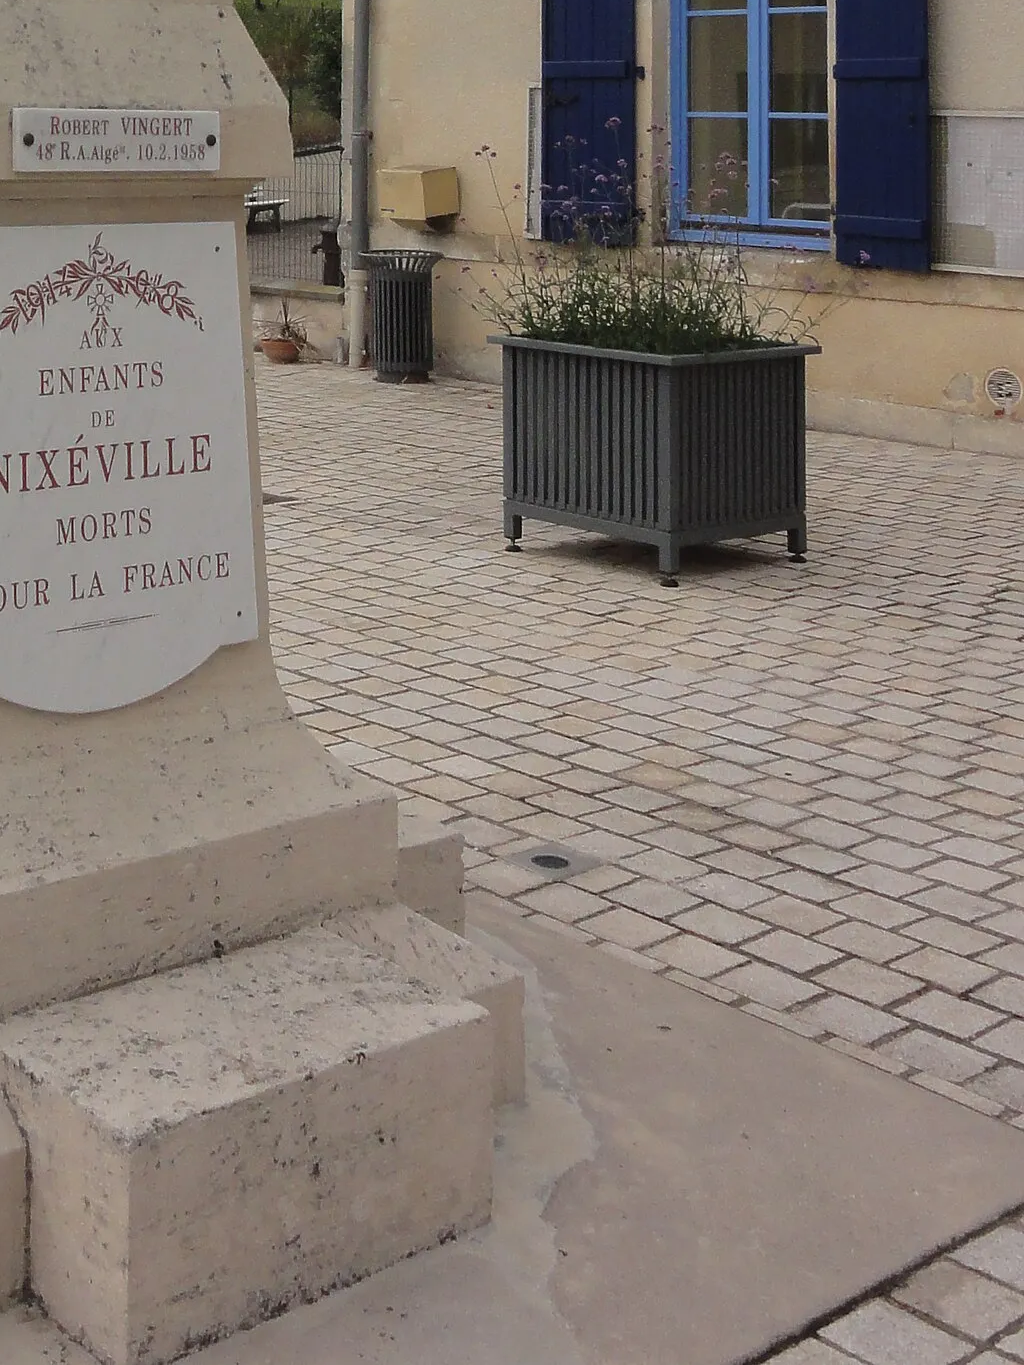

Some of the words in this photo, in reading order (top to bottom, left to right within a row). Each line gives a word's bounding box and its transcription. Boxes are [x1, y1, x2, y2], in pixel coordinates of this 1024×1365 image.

[50, 116, 110, 135] ROBERT
[120, 117, 194, 136] VINGERT
[137, 144, 206, 161] 10.2.1958
[38, 361, 165, 397] ENFANTS
[91, 409, 116, 428] DE
[55, 507, 153, 546] MORTS
[69, 571, 106, 602] LA
[122, 552, 231, 594] FRANCE
